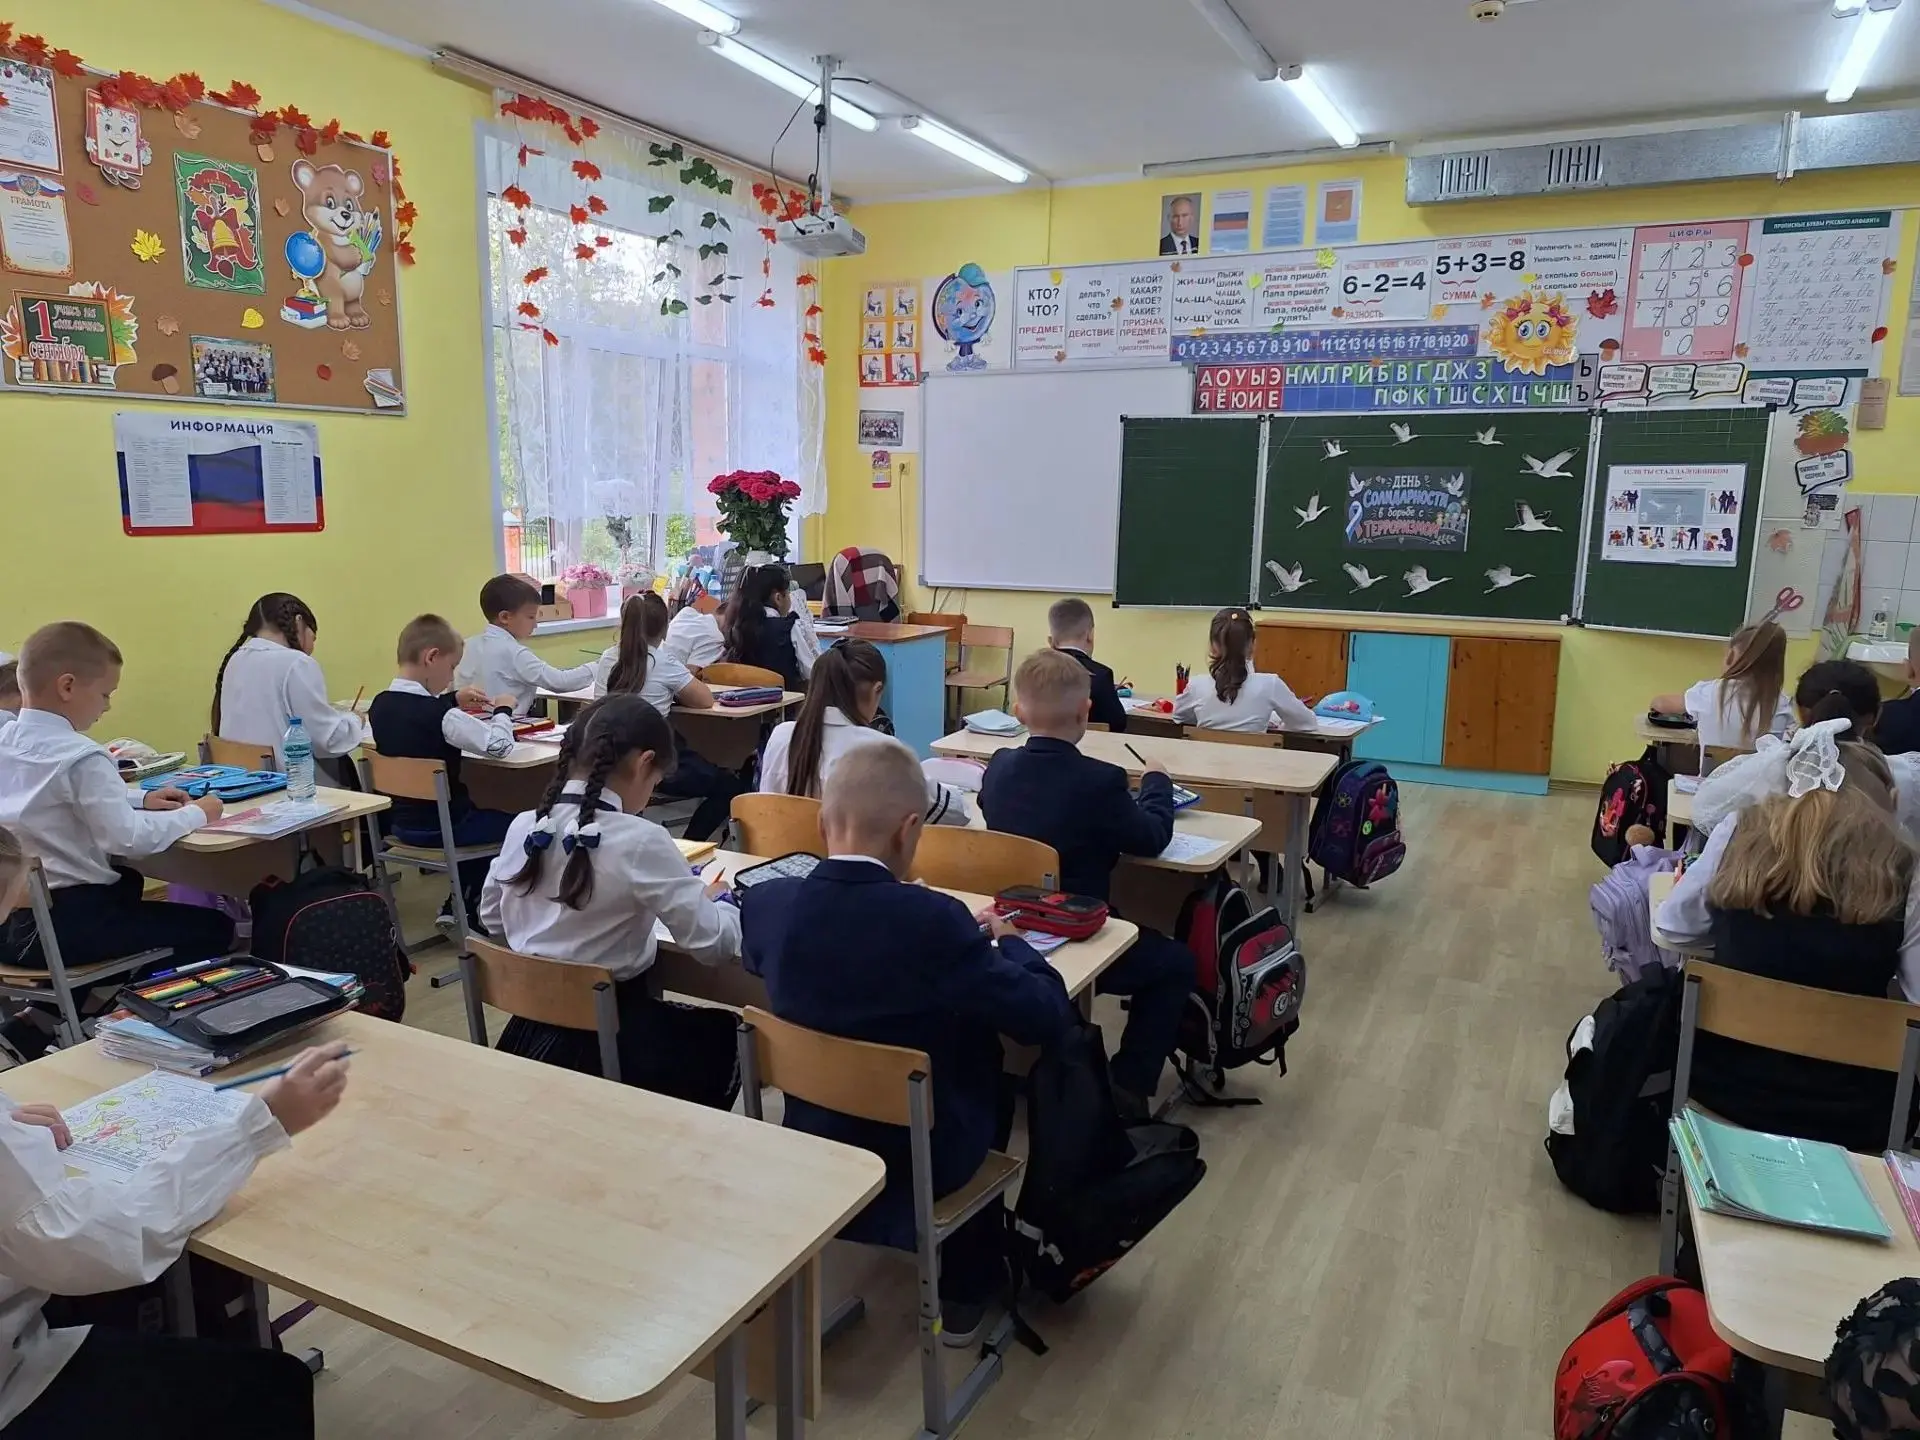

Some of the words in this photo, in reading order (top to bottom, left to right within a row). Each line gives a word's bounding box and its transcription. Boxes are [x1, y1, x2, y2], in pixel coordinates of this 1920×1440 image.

[10, 196, 52, 210] ГРАМОТА
[1825, 219, 1850, 227] РУССКОГО
[1668, 229, 1712, 238] ЦИФРЫ
[1590, 241, 1617, 249] единиц
[1435, 250, 1526, 275] 5+3=8
[1659, 248, 1672, 272] 1
[1688, 247, 1705, 269] 2
[1721, 245, 1737, 267] 3
[1217, 271, 1244, 279] ЛЫЖИ
[1265, 274, 1288, 282] Папа
[1580, 270, 1614, 278] больше
[1130, 275, 1163, 285] КАКОЙ?
[1176, 278, 1216, 286] ЖИ-ШИ
[1216, 280, 1243, 288] ШИНА
[1342, 271, 1426, 295] 6-2=4
[1130, 285, 1163, 295] КАКАЯ?
[1655, 277, 1669, 299] 4
[1685, 276, 1701, 298] 5
[1717, 274, 1733, 297] 6
[1028, 288, 1060, 300] КТО?
[1078, 289, 1111, 300] делать?
[1263, 290, 1285, 298] Папа
[1287, 286, 1330, 297] пришёл?
[1442, 290, 1477, 300] СУММА
[1129, 296, 1162, 305] КАКОЕ?
[1175, 296, 1214, 304] ЧА-ЩА
[1213, 298, 1246, 306] ЧАШКА
[1027, 304, 1059, 317] ЧТО?
[1129, 307, 1161, 316] КАКИЕ?
[1214, 308, 1242, 317] ЧУЛОК
[1344, 310, 1384, 320] РАЗНОСТЬ
[1651, 306, 1665, 328] 7
[1680, 305, 1697, 327] 8
[1714, 303, 1730, 326] 9
[28, 300, 58, 342] 1
[1076, 311, 1112, 322] сделать?
[1174, 314, 1213, 323] ЧУ-ЩУ
[1122, 318, 1165, 327] ПРИЗНАК
[1214, 318, 1240, 326] ЩУКА
[1018, 325, 1064, 335] ПРЕДМЕТ
[1068, 328, 1116, 339] ДЕЙСТВИЕ
[1119, 328, 1168, 337] ПРЕДМЕТА
[1178, 343, 1186, 356] 0
[1189, 343, 1196, 356] 1
[1199, 342, 1208, 355] 2
[1211, 341, 1219, 355] 3
[1222, 341, 1231, 355] 4
[1235, 341, 1244, 354] 5
[1247, 340, 1255, 354] 6
[1259, 340, 1267, 354] 7
[1270, 339, 1279, 354] 8
[1282, 339, 1291, 353] 9
[1294, 339, 1311, 353] 10
[1320, 338, 1332, 351] 11
[1333, 338, 1347, 351] 12
[1347, 337, 1361, 351] 13
[1362, 337, 1376, 350] 14
[1378, 336, 1391, 350] 15
[1392, 336, 1406, 349] 16
[1407, 335, 1422, 348] 17
[1422, 334, 1436, 348] 18
[1437, 334, 1451, 347] 19
[1452, 334, 1468, 347] 20
[1677, 334, 1693, 356] 0
[29, 336, 85, 370] сентября
[170, 420, 274, 436] ИНФОРМАЦИЯ
[1391, 475, 1421, 489] ДЕНЬ
[1362, 489, 1449, 509] СОЛИДАРНОСТИ
[1378, 507, 1384, 518] в
[1387, 505, 1415, 519] борьбе
[1418, 509, 1424, 517] с
